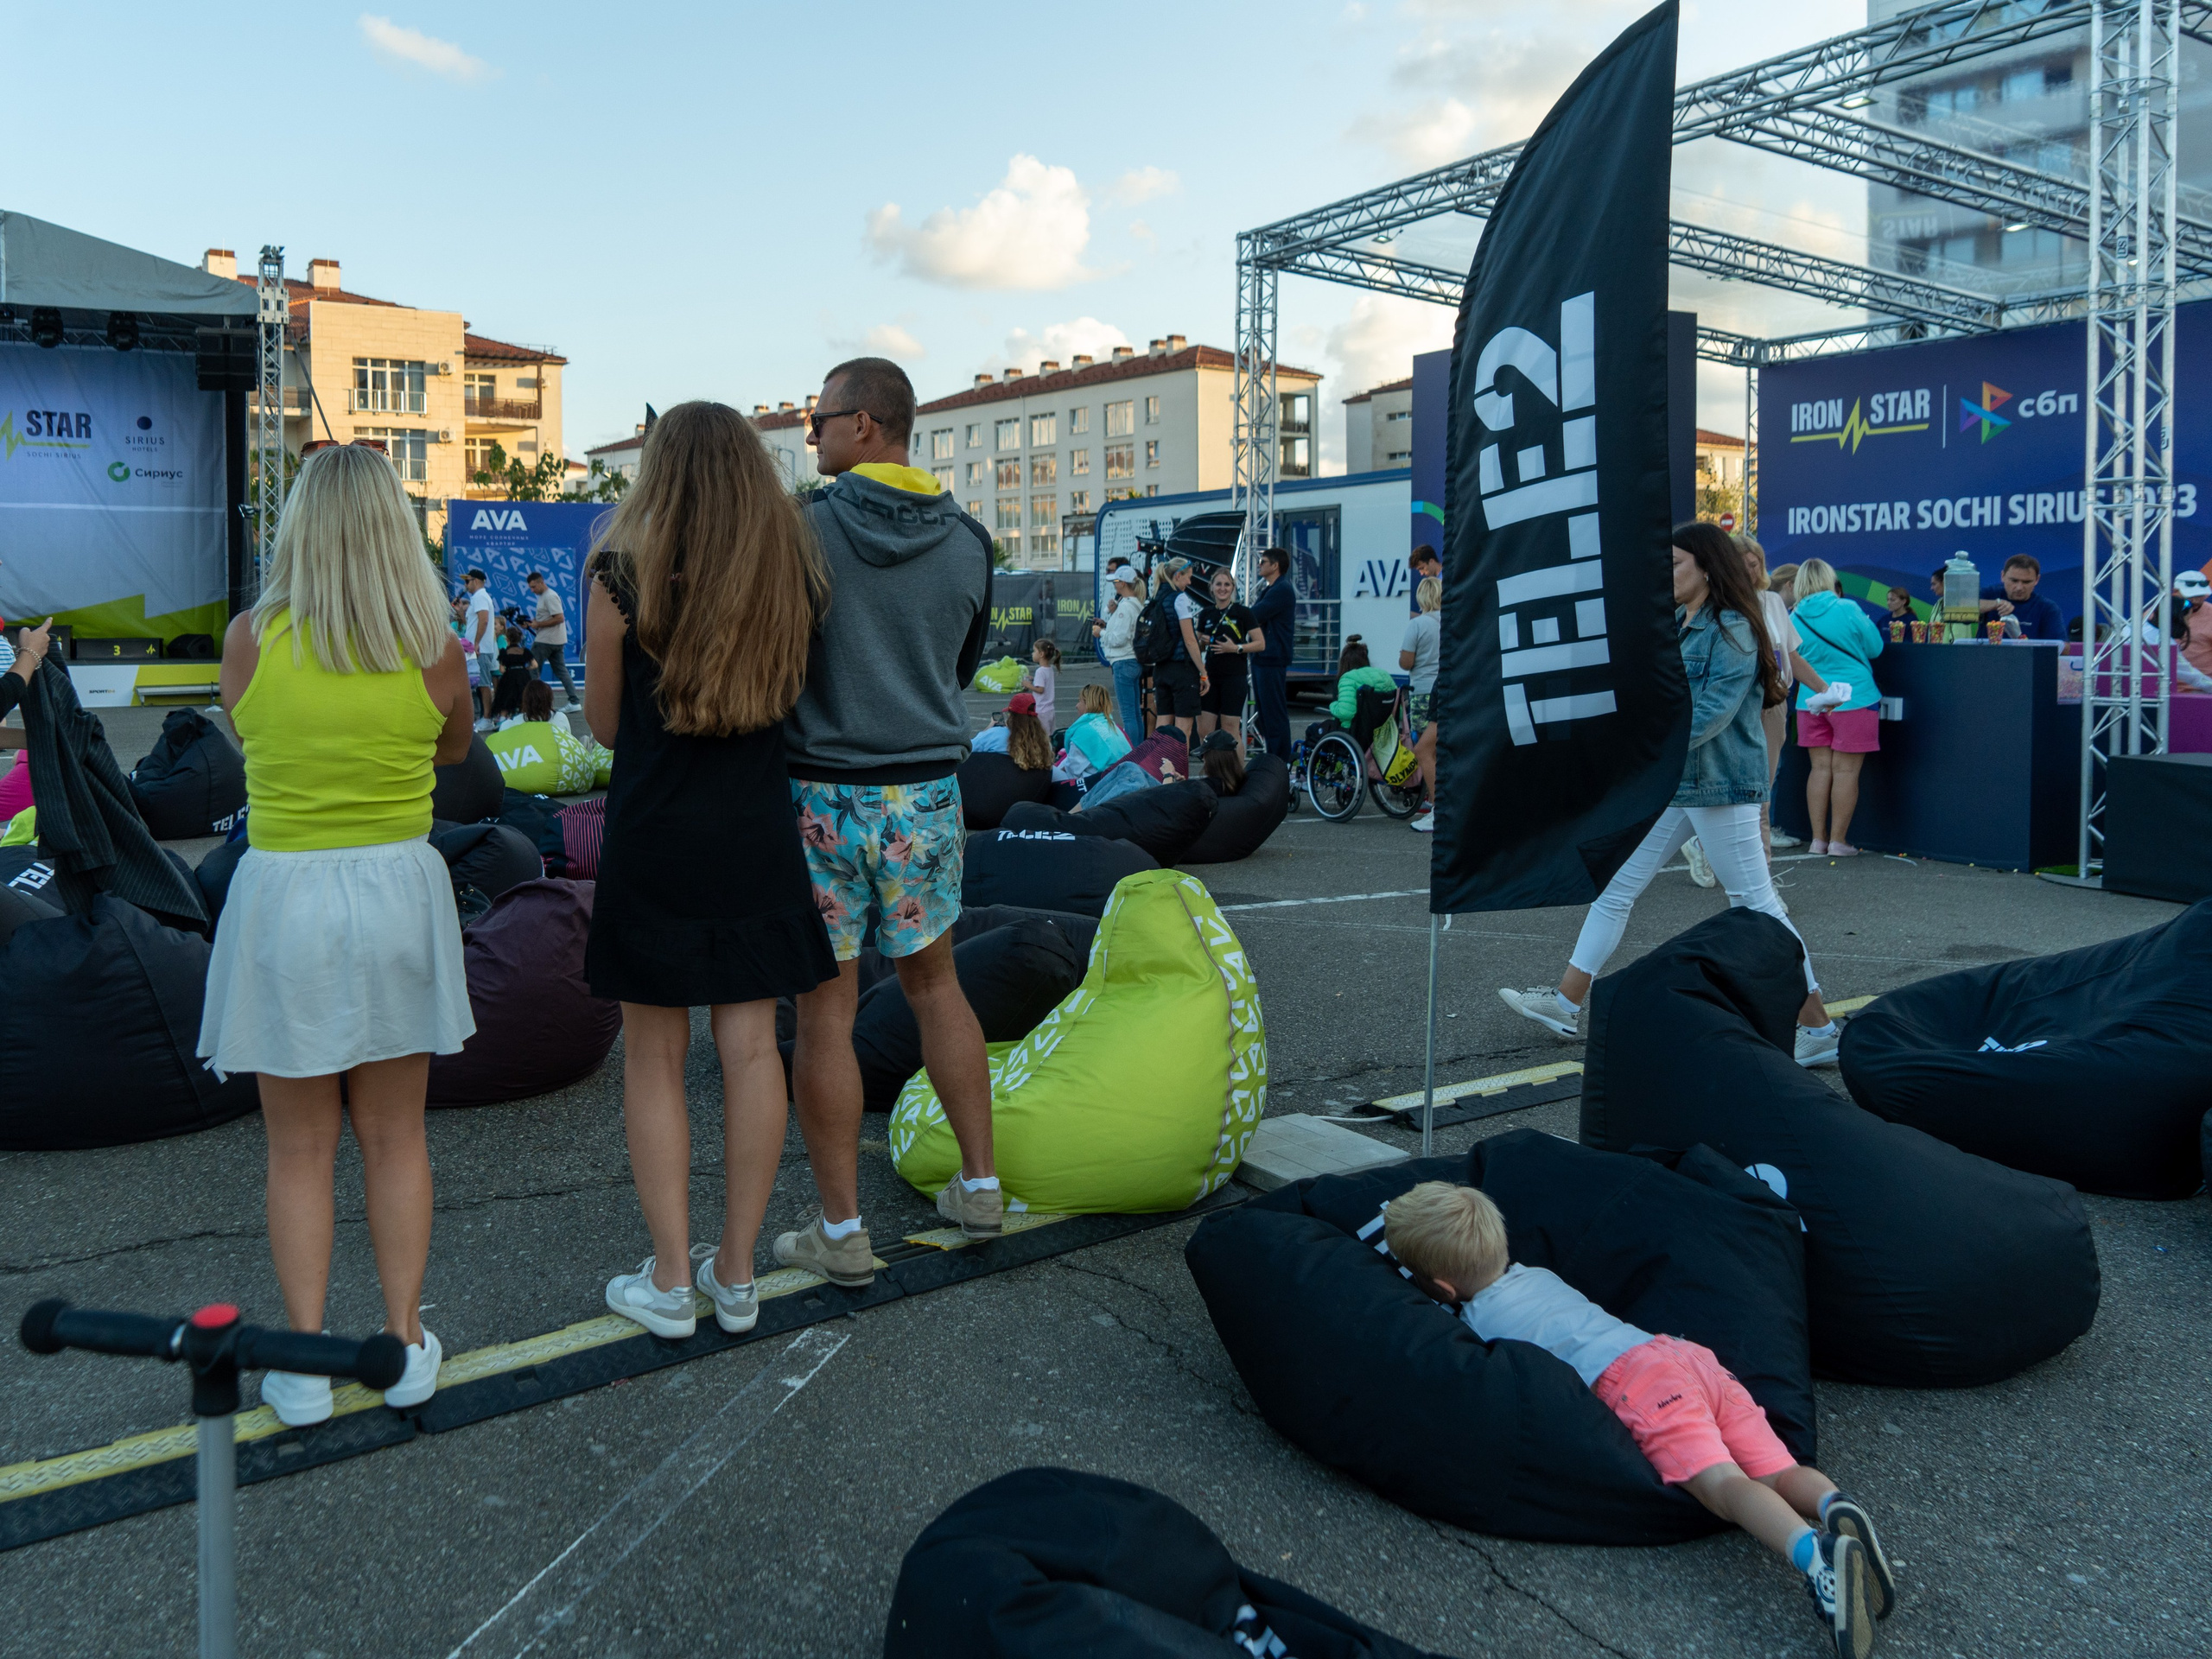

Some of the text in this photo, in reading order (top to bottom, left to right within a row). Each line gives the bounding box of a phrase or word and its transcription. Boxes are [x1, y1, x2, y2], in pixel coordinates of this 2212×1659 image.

[1791, 389, 1931, 433] IRON STAR
[2018, 390, 2079, 418] сбп
[26, 410, 92, 439] STAR
[125, 435, 165, 446] SIRIUS
[27, 450, 53, 459] SOCHI
[135, 467, 183, 480] Сириус
[470, 509, 528, 531] AVA
[1473, 290, 1618, 747] TELE2
[1788, 500, 1911, 536] IRONSTAR
[1916, 494, 2002, 530] SOCHI
[1008, 607, 1033, 620] STAR
[1057, 599, 1079, 613] IRON
[113, 645, 121, 657] 3
[213, 804, 251, 833] TELE
